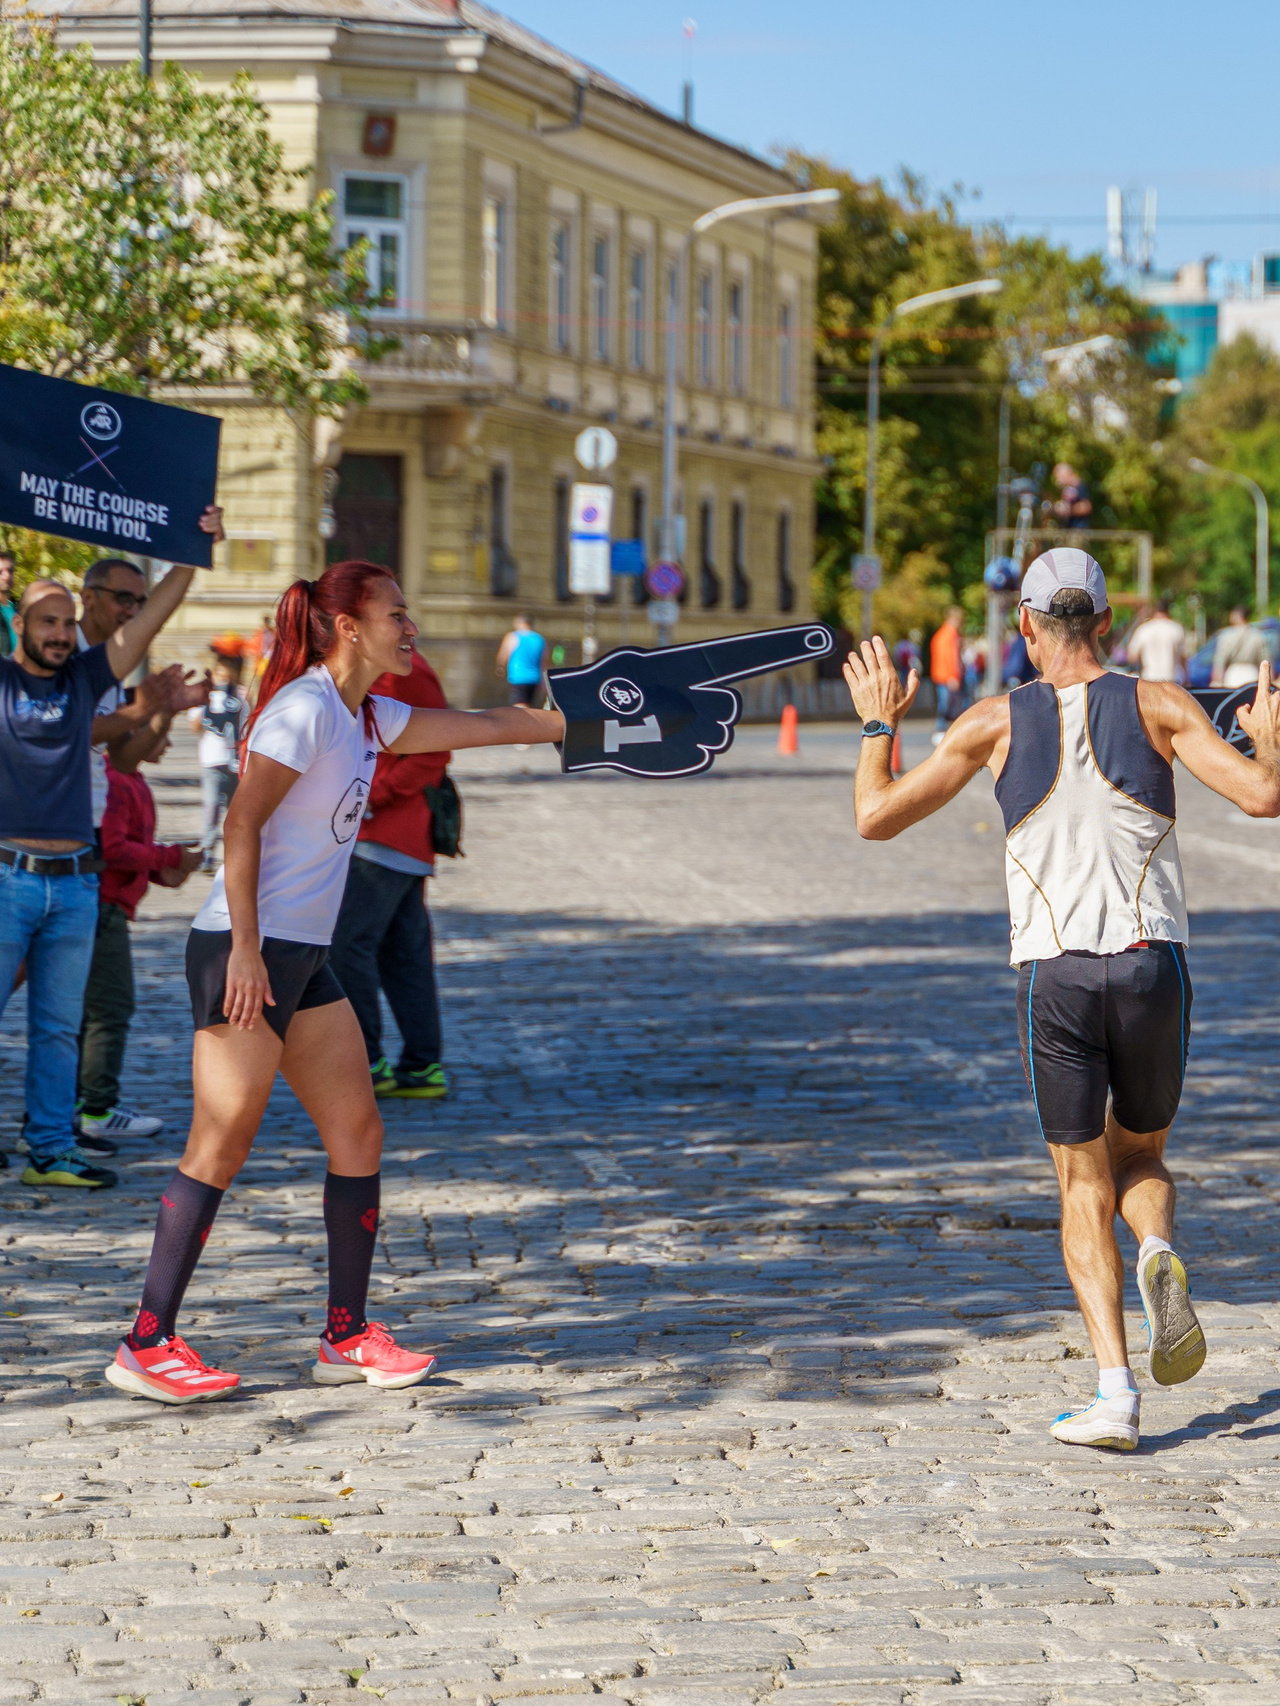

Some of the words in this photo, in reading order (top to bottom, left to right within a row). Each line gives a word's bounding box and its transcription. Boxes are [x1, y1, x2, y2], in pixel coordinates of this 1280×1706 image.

[20, 471, 59, 498] MAY
[62, 481, 96, 507] THE
[98, 490, 170, 526] COURSE
[34, 496, 58, 520] BE
[60, 502, 109, 532] WITH
[111, 515, 152, 543] YOU.
[604, 714, 662, 753] 1
